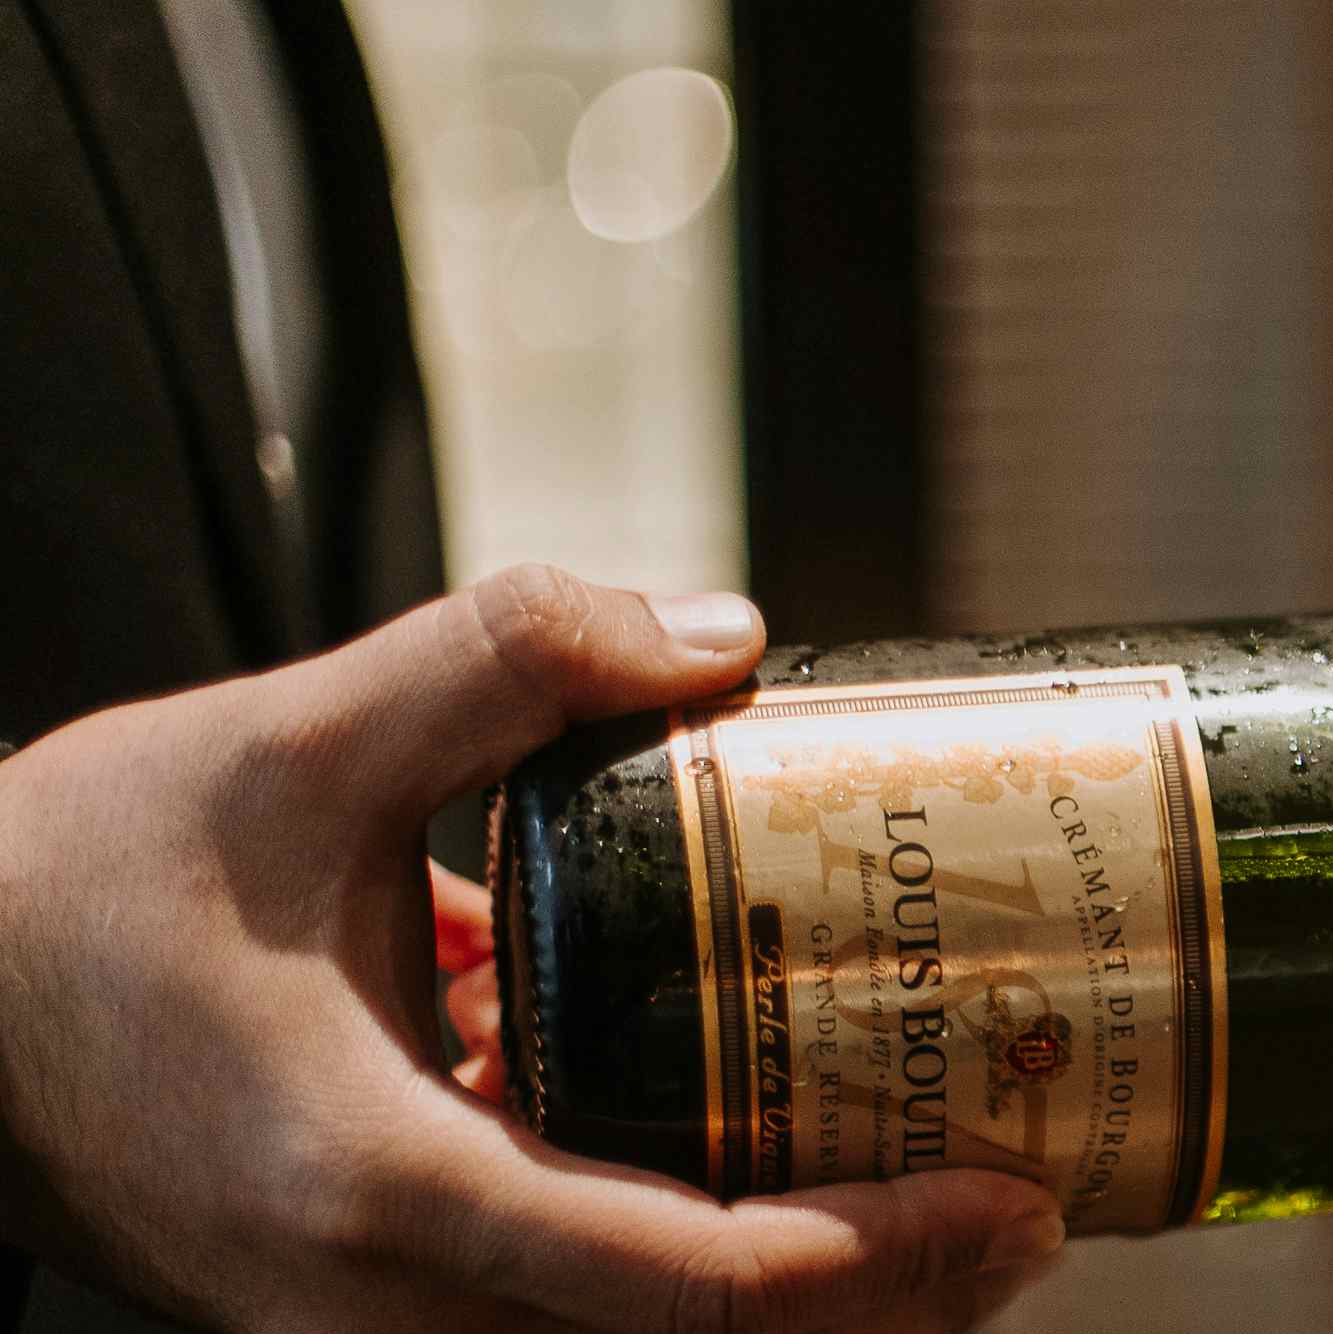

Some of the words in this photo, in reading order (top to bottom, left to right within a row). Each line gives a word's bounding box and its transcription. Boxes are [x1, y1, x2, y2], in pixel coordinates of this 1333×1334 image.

[857, 848, 877, 918] Maison
[883, 806, 944, 990] LOUIS
[1049, 796, 1130, 976] CRÉMANT
[755, 942, 788, 1047] Perle
[810, 923, 838, 1056] GRANDE
[865, 927, 892, 993] Fondée
[1072, 895, 1104, 1009] APPELLATION
[870, 998, 884, 1020] en
[870, 1023, 892, 1070] 1877
[1108, 994, 1136, 1042] DE
[762, 1056, 789, 1094] de
[901, 1004, 948, 1175] BOUIL
[1075, 1058, 1138, 1210] BOURGO
